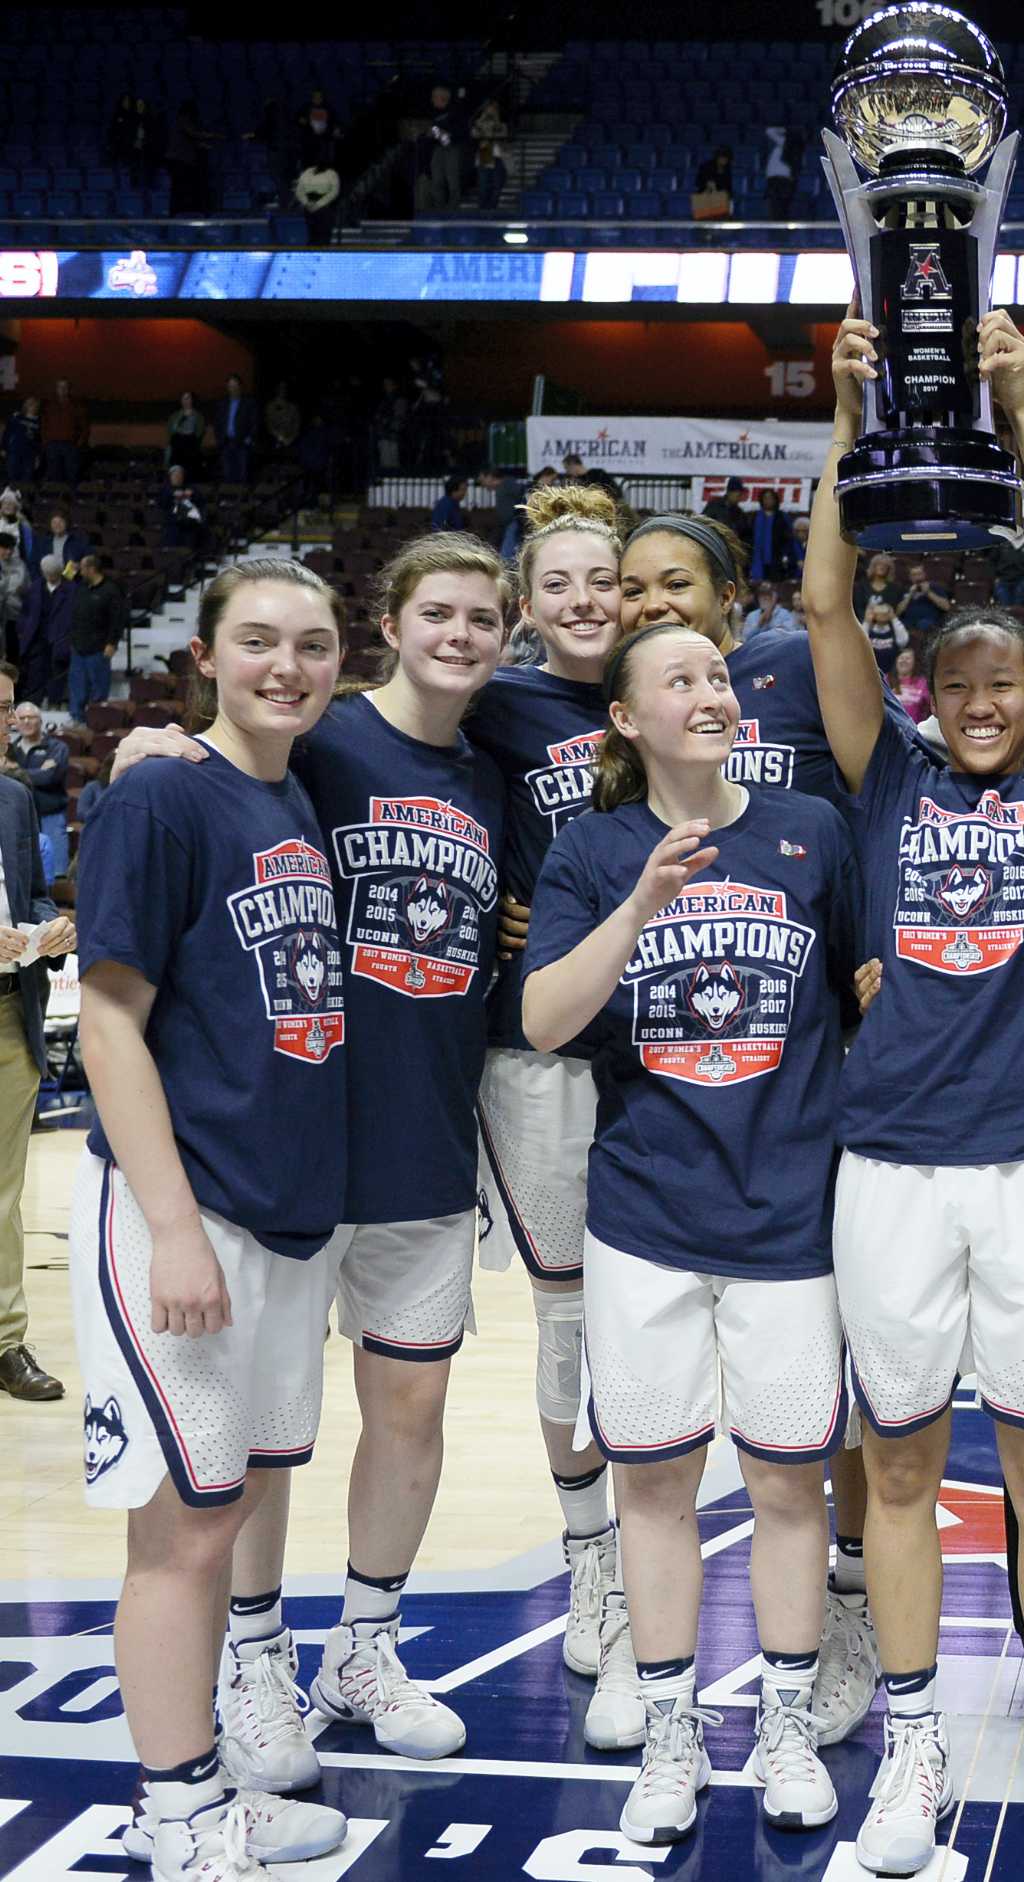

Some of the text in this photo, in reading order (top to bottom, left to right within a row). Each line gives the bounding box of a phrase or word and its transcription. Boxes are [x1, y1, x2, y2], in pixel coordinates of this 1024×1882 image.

[426, 253, 543, 283] AMERI
[765, 361, 816, 397] 15
[904, 375, 956, 384] CHAMPION
[541, 439, 647, 457] AMERICAN
[703, 476, 802, 503] EPN
[380, 803, 485, 847] AMERICAN
[343, 830, 498, 902] CHAMPIONS
[368, 885, 398, 901] 2014
[904, 887, 926, 902] 2015
[366, 905, 397, 921] 2015
[898, 911, 931, 922] UCONN
[356, 927, 400, 944] UCONN
[978, 930, 1022, 940] BASKETBAL
[650, 979, 787, 1000] 2014 2016
[648, 999, 786, 1019] 2015 2017
[641, 1028, 684, 1039] UCONN
[666, 1045, 701, 1053] WOMEN'S
[731, 1042, 778, 1051] BASKETBALL
